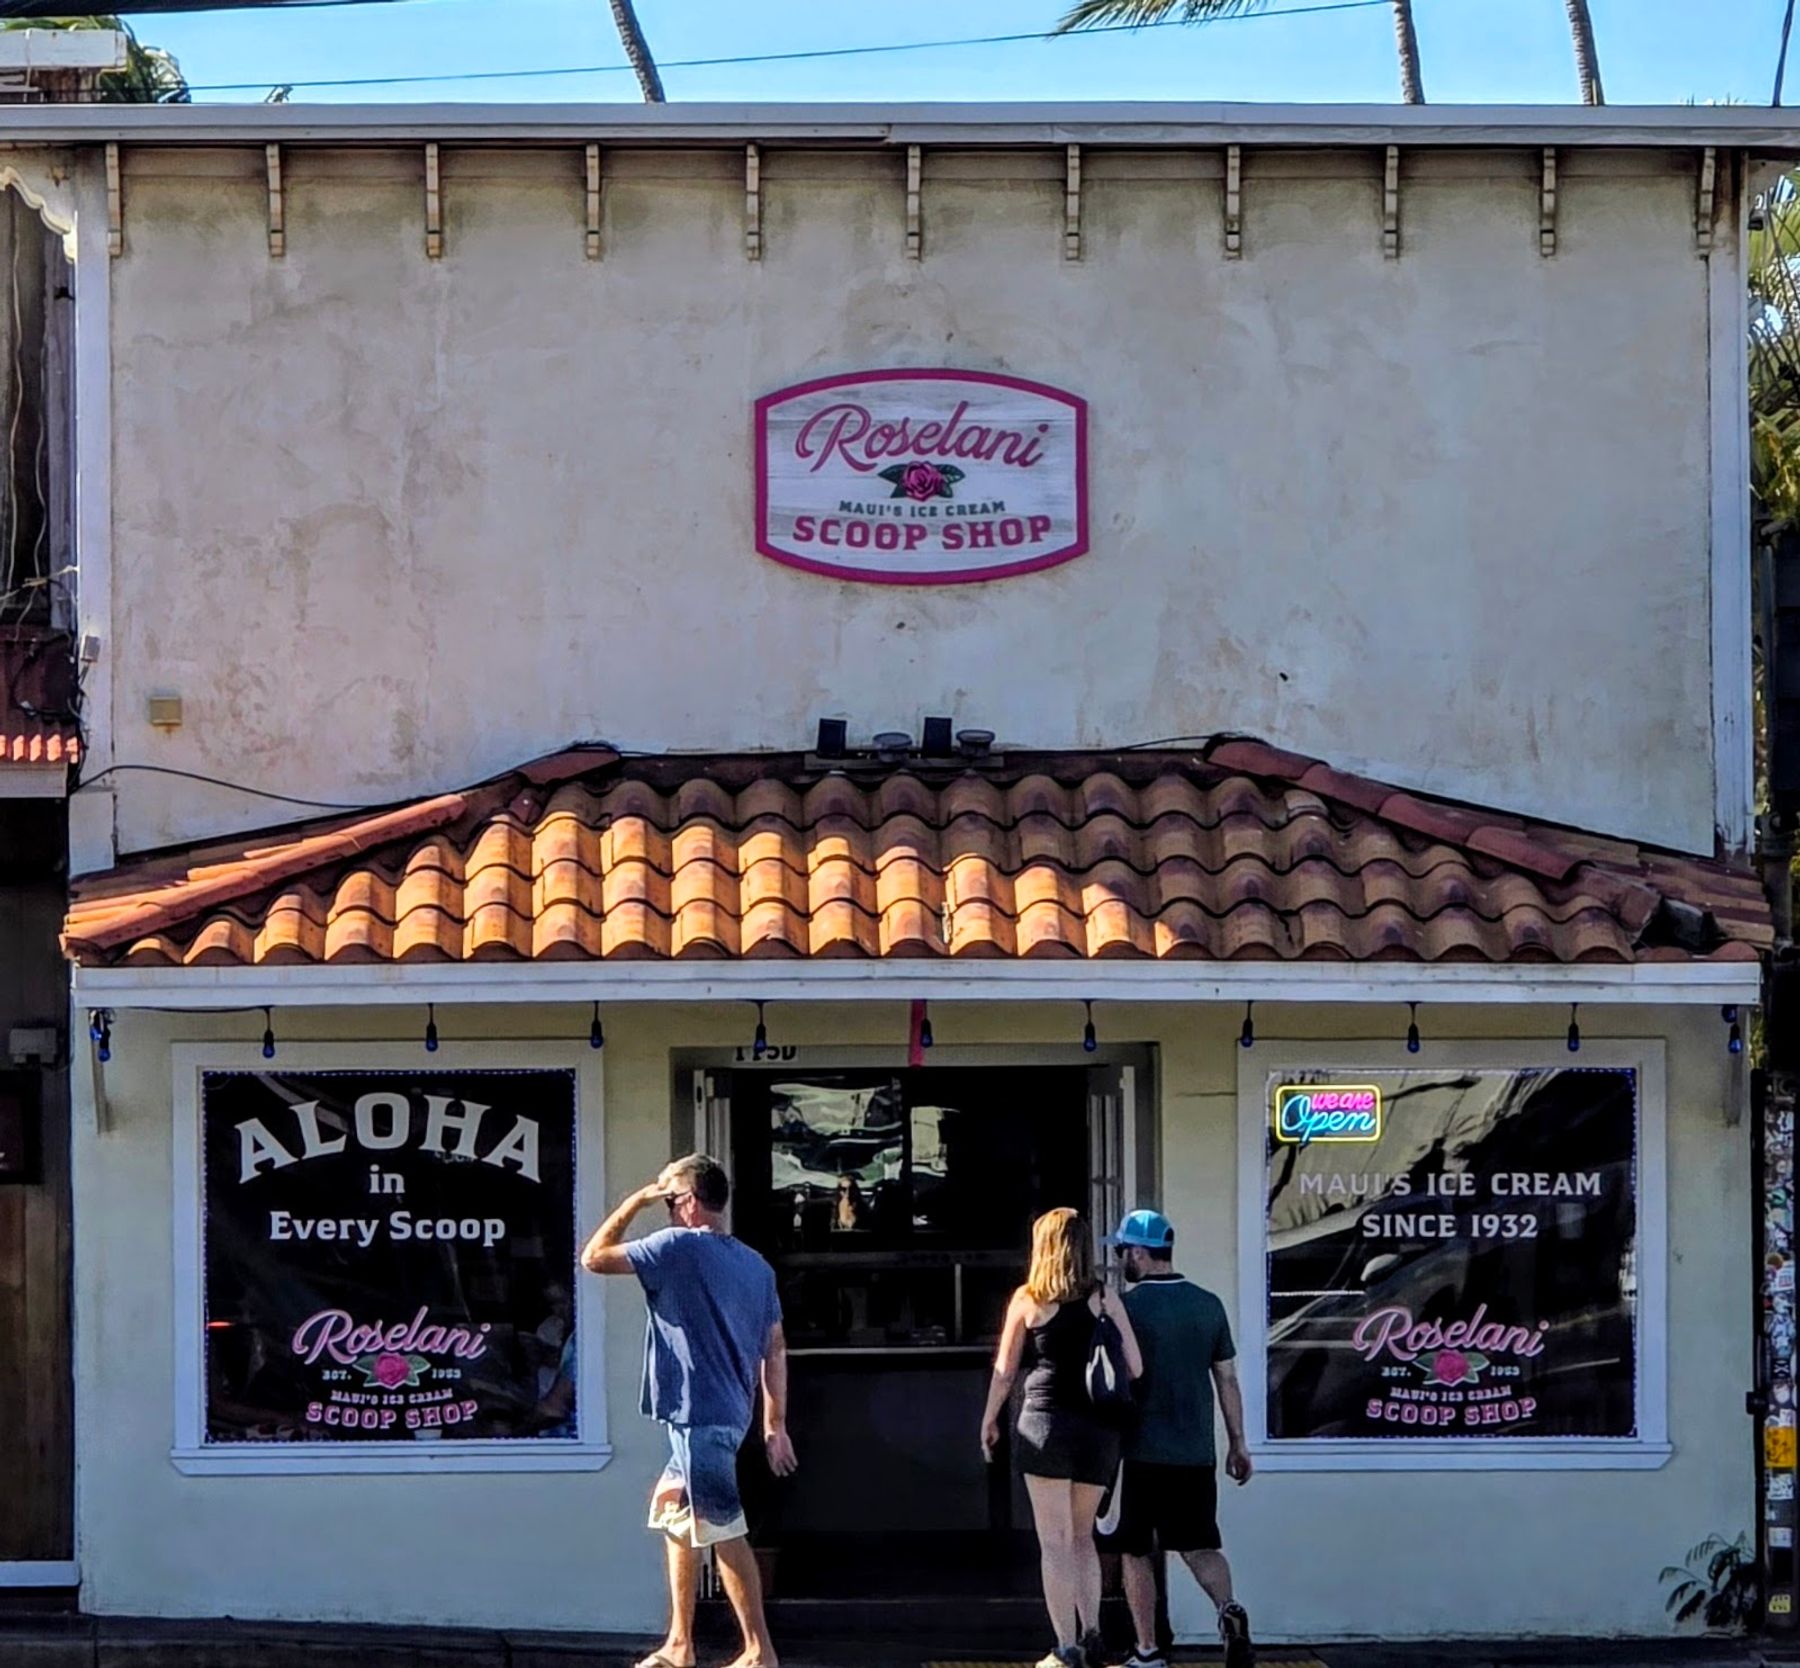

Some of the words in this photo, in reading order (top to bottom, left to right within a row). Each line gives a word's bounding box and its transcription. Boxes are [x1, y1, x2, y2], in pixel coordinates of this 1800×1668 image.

[795, 401, 1049, 472] Roselani
[838, 500, 902, 518] MAUI'S
[910, 502, 938, 518] ICE
[945, 501, 1006, 516] CREAM
[793, 516, 928, 550] SCOOP
[941, 515, 1052, 550] SHOP
[1282, 1094, 1376, 1144] Open
[234, 1092, 542, 1184] ALOHA
[369, 1164, 405, 1194] in
[1300, 1173, 1411, 1196] MAUI'S
[1427, 1173, 1476, 1196] ICE
[1491, 1172, 1602, 1196] CREAM
[270, 1211, 379, 1248] Every
[389, 1211, 506, 1247] Scoop
[1362, 1214, 1456, 1238] SINCE
[1471, 1214, 1538, 1238] 1932
[292, 1305, 491, 1365] Roselani
[1352, 1303, 1549, 1361] Roselani
[331, 1389, 378, 1405] MAUI'S
[383, 1394, 404, 1405] ICE
[409, 1388, 453, 1404] CREAM
[1390, 1386, 1437, 1401] MAUI'S
[1441, 1391, 1463, 1402] ICE
[1468, 1385, 1512, 1401] CREAM
[306, 1401, 397, 1429] SCOOP
[405, 1400, 478, 1428] SHOP
[1366, 1398, 1456, 1426] SCOOP
[1464, 1397, 1537, 1426] SHOP
